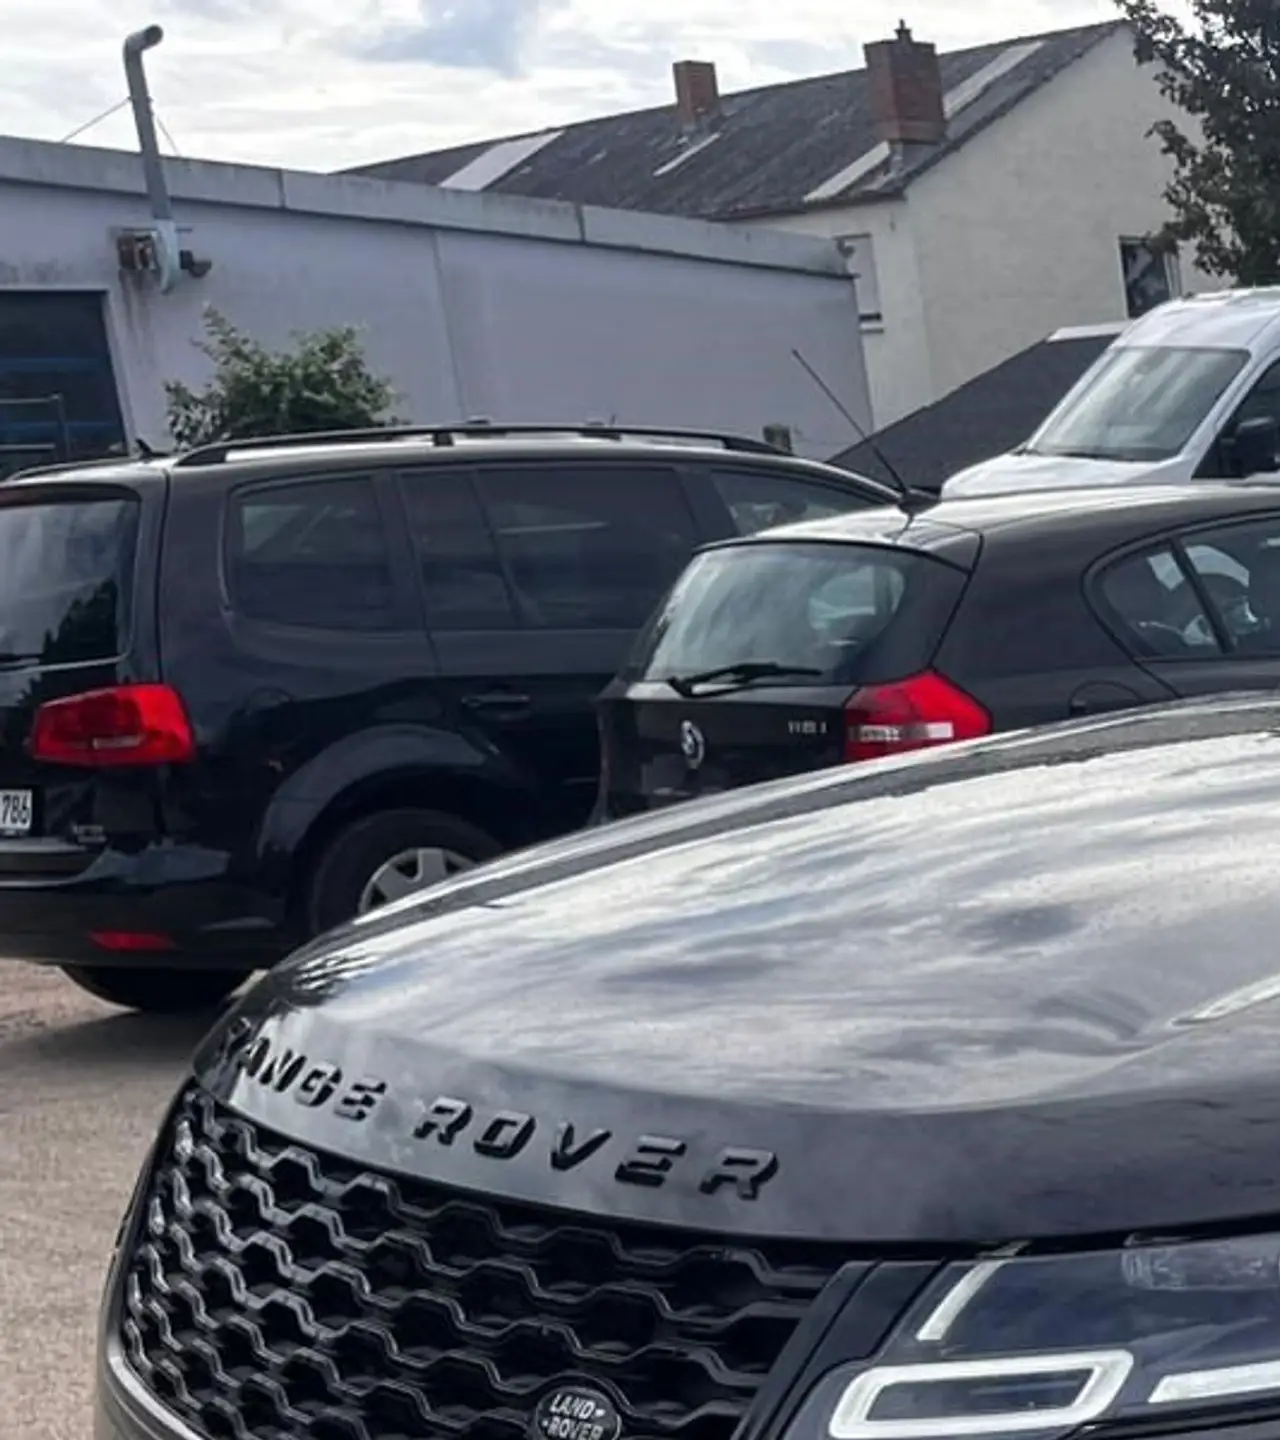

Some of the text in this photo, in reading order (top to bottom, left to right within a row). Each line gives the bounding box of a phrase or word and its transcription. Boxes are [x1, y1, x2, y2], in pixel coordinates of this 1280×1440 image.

[2, 794, 29, 824] 786
[413, 1095, 780, 1201] ROVER
[549, 1393, 596, 1420] LAND
